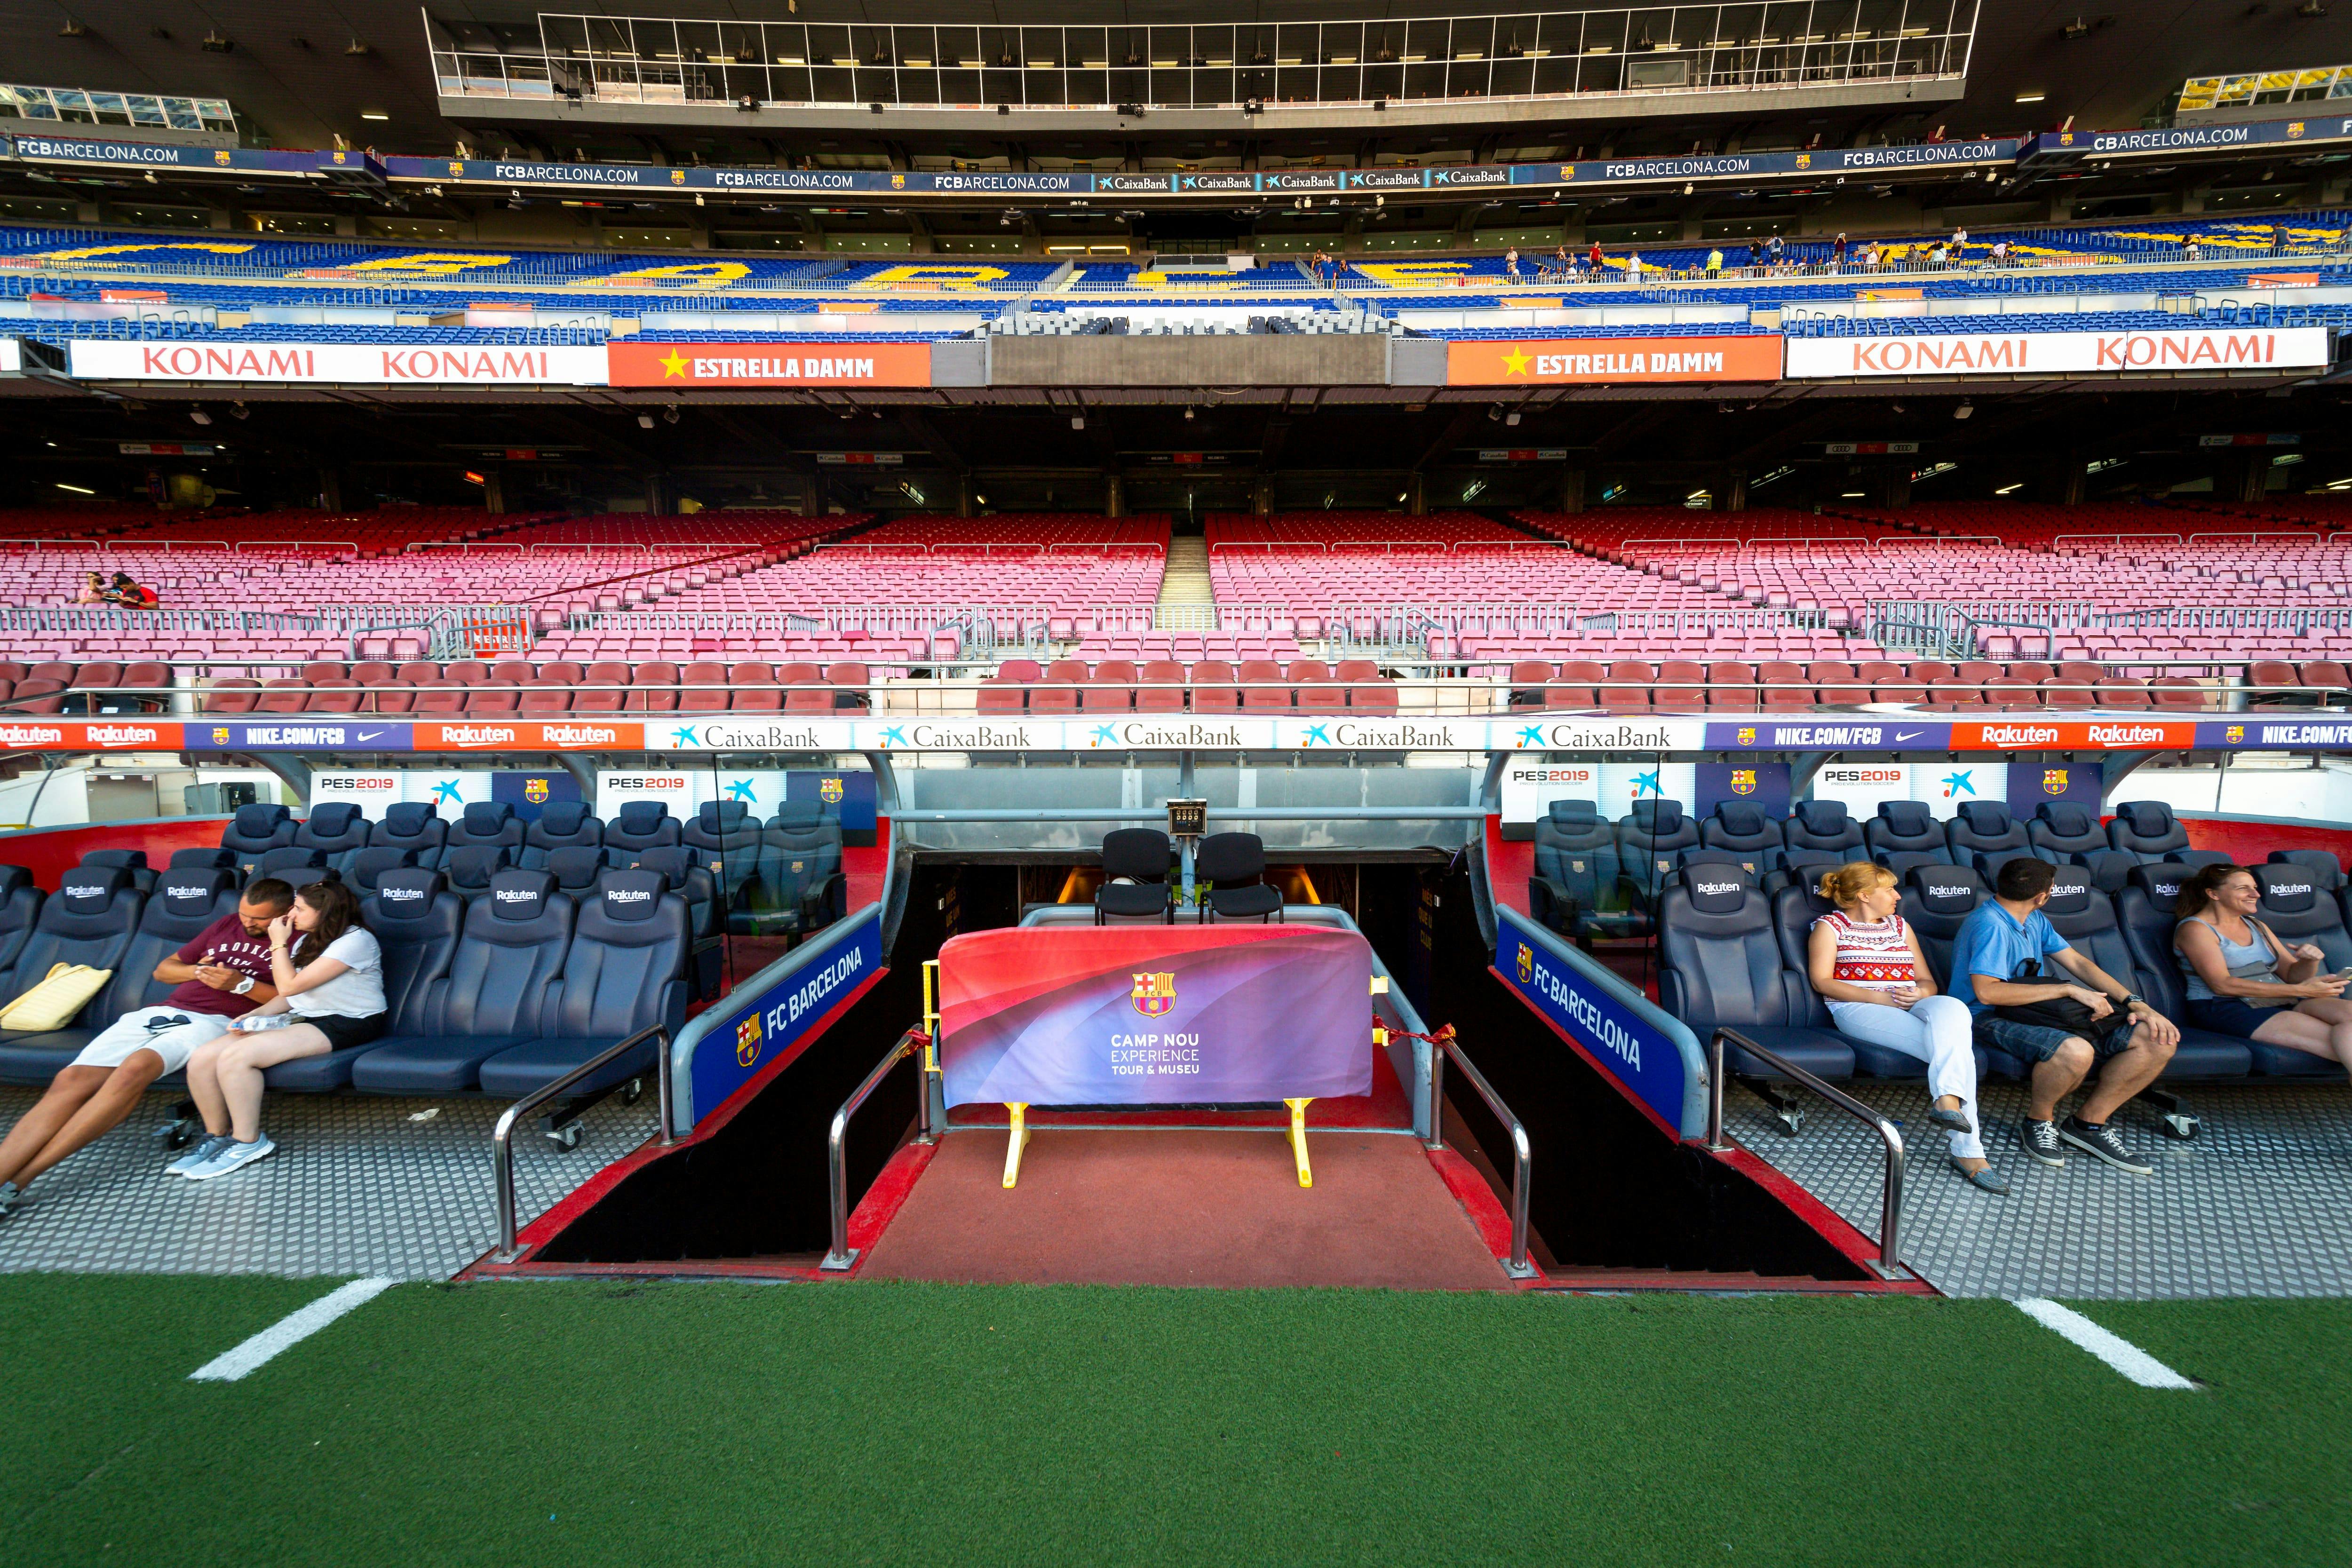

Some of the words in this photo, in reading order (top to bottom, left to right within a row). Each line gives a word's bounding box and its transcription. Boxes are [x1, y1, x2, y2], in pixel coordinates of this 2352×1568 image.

[2094, 128, 2248, 151] CBARCELONA.COM
[19, 140, 179, 162] FCBARCELONA.COM
[1844, 144, 1996, 166] FCBARCELONA.COM
[496, 165, 638, 182] FCBARCELONA.COM
[1606, 159, 1749, 177] FCBARCELONA.COM
[716, 173, 852, 188] FCBARCELONA.COM
[935, 176, 1069, 189] FCBARCELONA.COM
[1114, 178, 1168, 189] CaixaBank
[1198, 177, 1251, 189] CaixaBank
[1281, 175, 1335, 188] CaixaBank
[1366, 174, 1420, 186] CaixaBank
[1451, 170, 1506, 183] CaixaBank
[1853, 340, 2027, 371] KONAMI
[2097, 335, 2275, 365] KONAMI
[143, 347, 314, 376] KONAMI
[381, 350, 548, 378] KONAMI
[694, 358, 800, 378] ESTRELLA
[804, 358, 874, 378] DAMM
[1536, 354, 1647, 375] ESTRELLA
[1650, 352, 1724, 373] DAMM
[87, 726, 157, 742] Rakuten
[246, 728, 346, 745] NIKE.COM/FCB
[442, 726, 515, 742] Rakuten
[543, 725, 616, 742] Rakuten
[705, 726, 820, 747] CaixaBank
[914, 726, 1031, 747] CaixaBank
[1124, 723, 1242, 745] CaixaBank
[1336, 724, 1454, 746] CaixaBank
[1551, 725, 1671, 747] CaixaBank
[1775, 728, 1882, 745] NIKE.COM/FCB
[1982, 725, 2058, 742] Rakuten
[2088, 725, 2164, 742] Rakuten
[609, 778, 684, 788] PES2019
[1513, 771, 1589, 781] PES2019
[1825, 771, 1901, 781] PES2019
[322, 779, 393, 788] PES2019
[66, 886, 105, 896] Rakuten
[167, 886, 207, 896] Rakuten
[383, 888, 423, 899] Rakuten
[1698, 882, 1740, 893] Rakuten
[1929, 886, 1970, 895] Rakuten
[2050, 884, 2085, 894] akuten
[2156, 884, 2181, 894] Raku
[2270, 884, 2311, 894] Rakuten
[496, 890, 537, 900] Rakuten
[608, 890, 650, 900] Rakuten
[767, 1003, 787, 1040] FC
[789, 946, 862, 1022] BARCELONA
[1534, 963, 1549, 994] FC
[1550, 975, 1640, 1072] BARCELONA
[1111, 1034, 1158, 1047] CAMP
[1164, 1033, 1199, 1046] NOU
[1111, 1049, 1200, 1062] EXPERIENCE
[1112, 1065, 1144, 1075] TOUR
[1147, 1065, 1155, 1075] &
[1158, 1064, 1200, 1074] MUSEU
